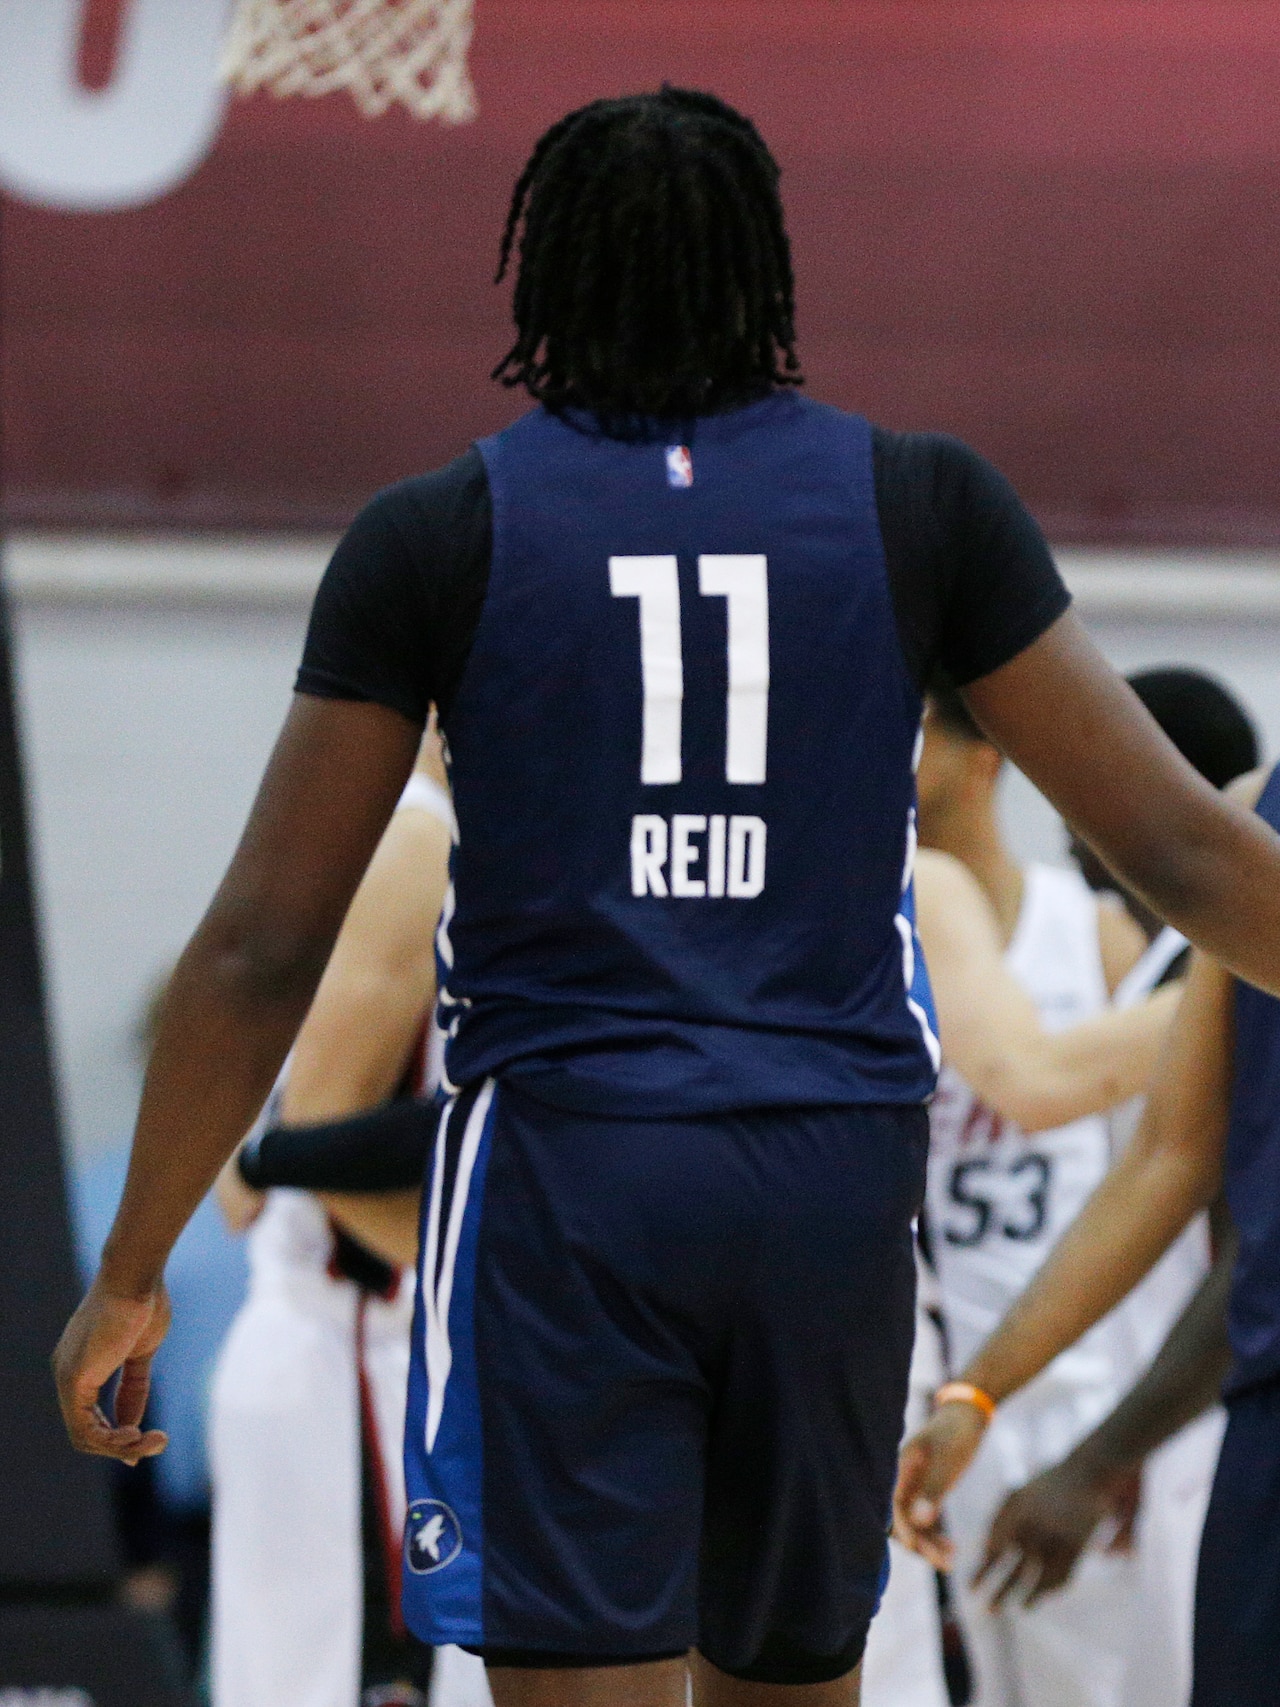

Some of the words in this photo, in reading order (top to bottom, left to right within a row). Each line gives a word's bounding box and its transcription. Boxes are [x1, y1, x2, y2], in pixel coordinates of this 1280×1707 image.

[608, 553, 769, 785] 11
[630, 813, 767, 899] REID
[944, 1152, 1050, 1247] 53
